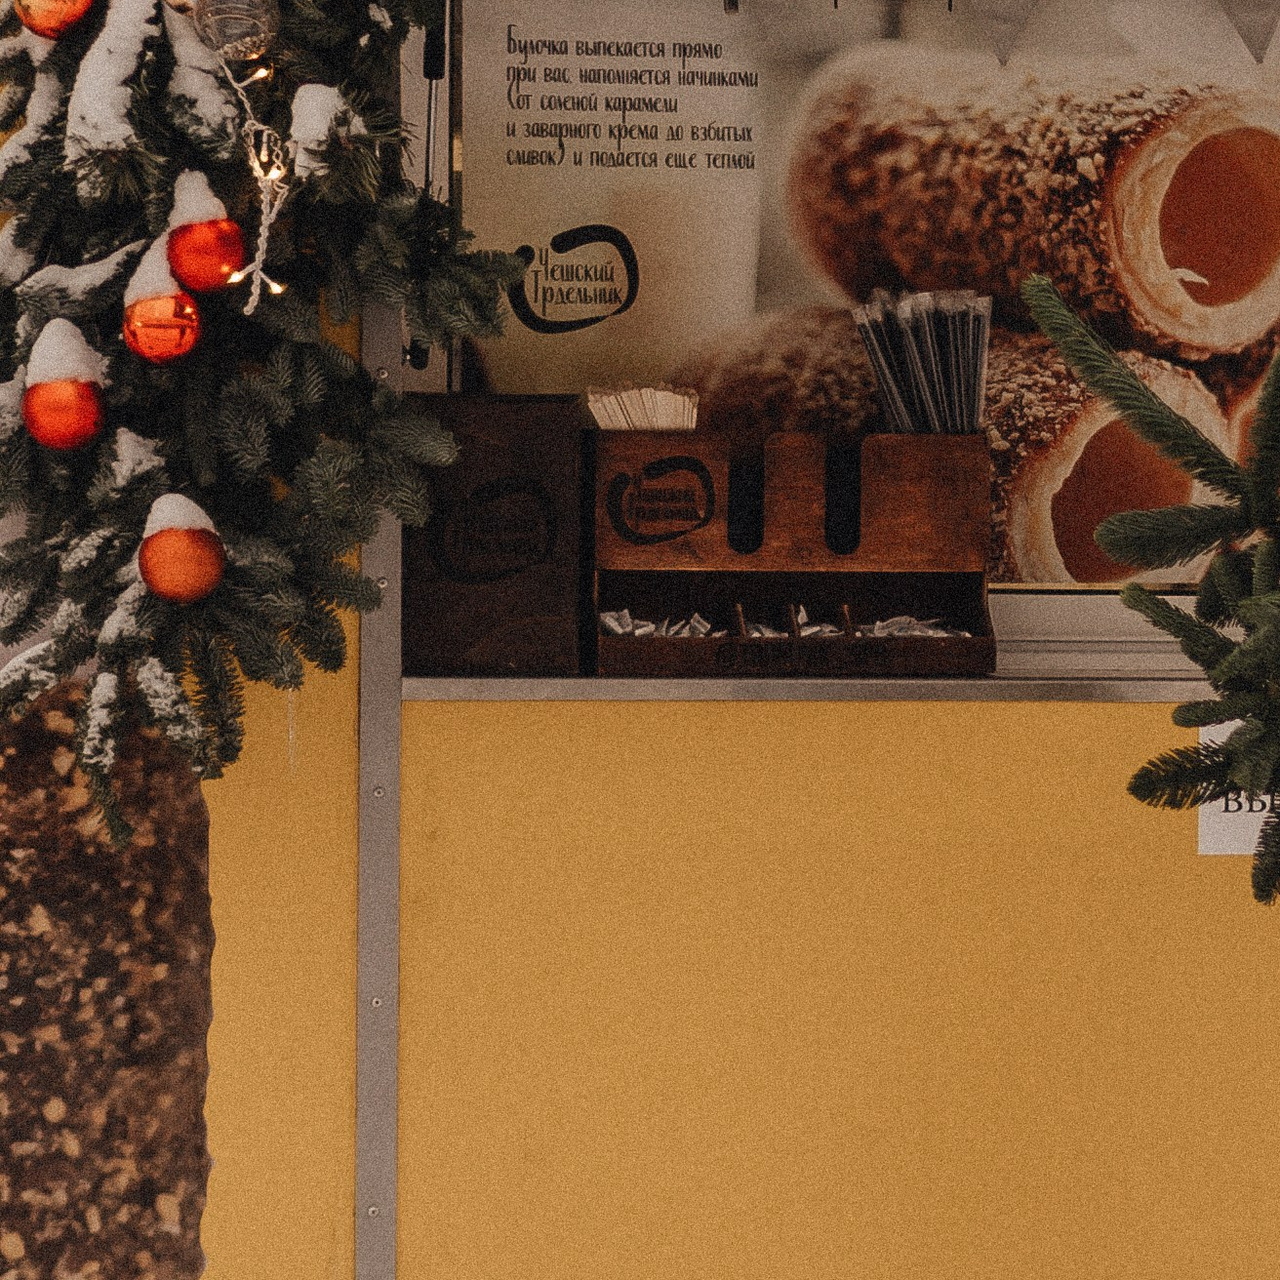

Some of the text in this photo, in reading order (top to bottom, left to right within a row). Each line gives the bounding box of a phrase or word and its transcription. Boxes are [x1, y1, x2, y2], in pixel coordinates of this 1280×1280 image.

[507, 24, 722, 69] Булочка выпекается прямо
[507, 66, 536, 93] при
[579, 69, 670, 85] наполняется
[678, 71, 758, 87] начинками
[507, 86, 677, 125] (от соленой карамели
[506, 123, 752, 150] и заварного крема до взбитых
[506, 136, 755, 169] сливок) и подается еще теплой
[539, 248, 614, 282] Чешский
[532, 270, 622, 316] Трдельник
